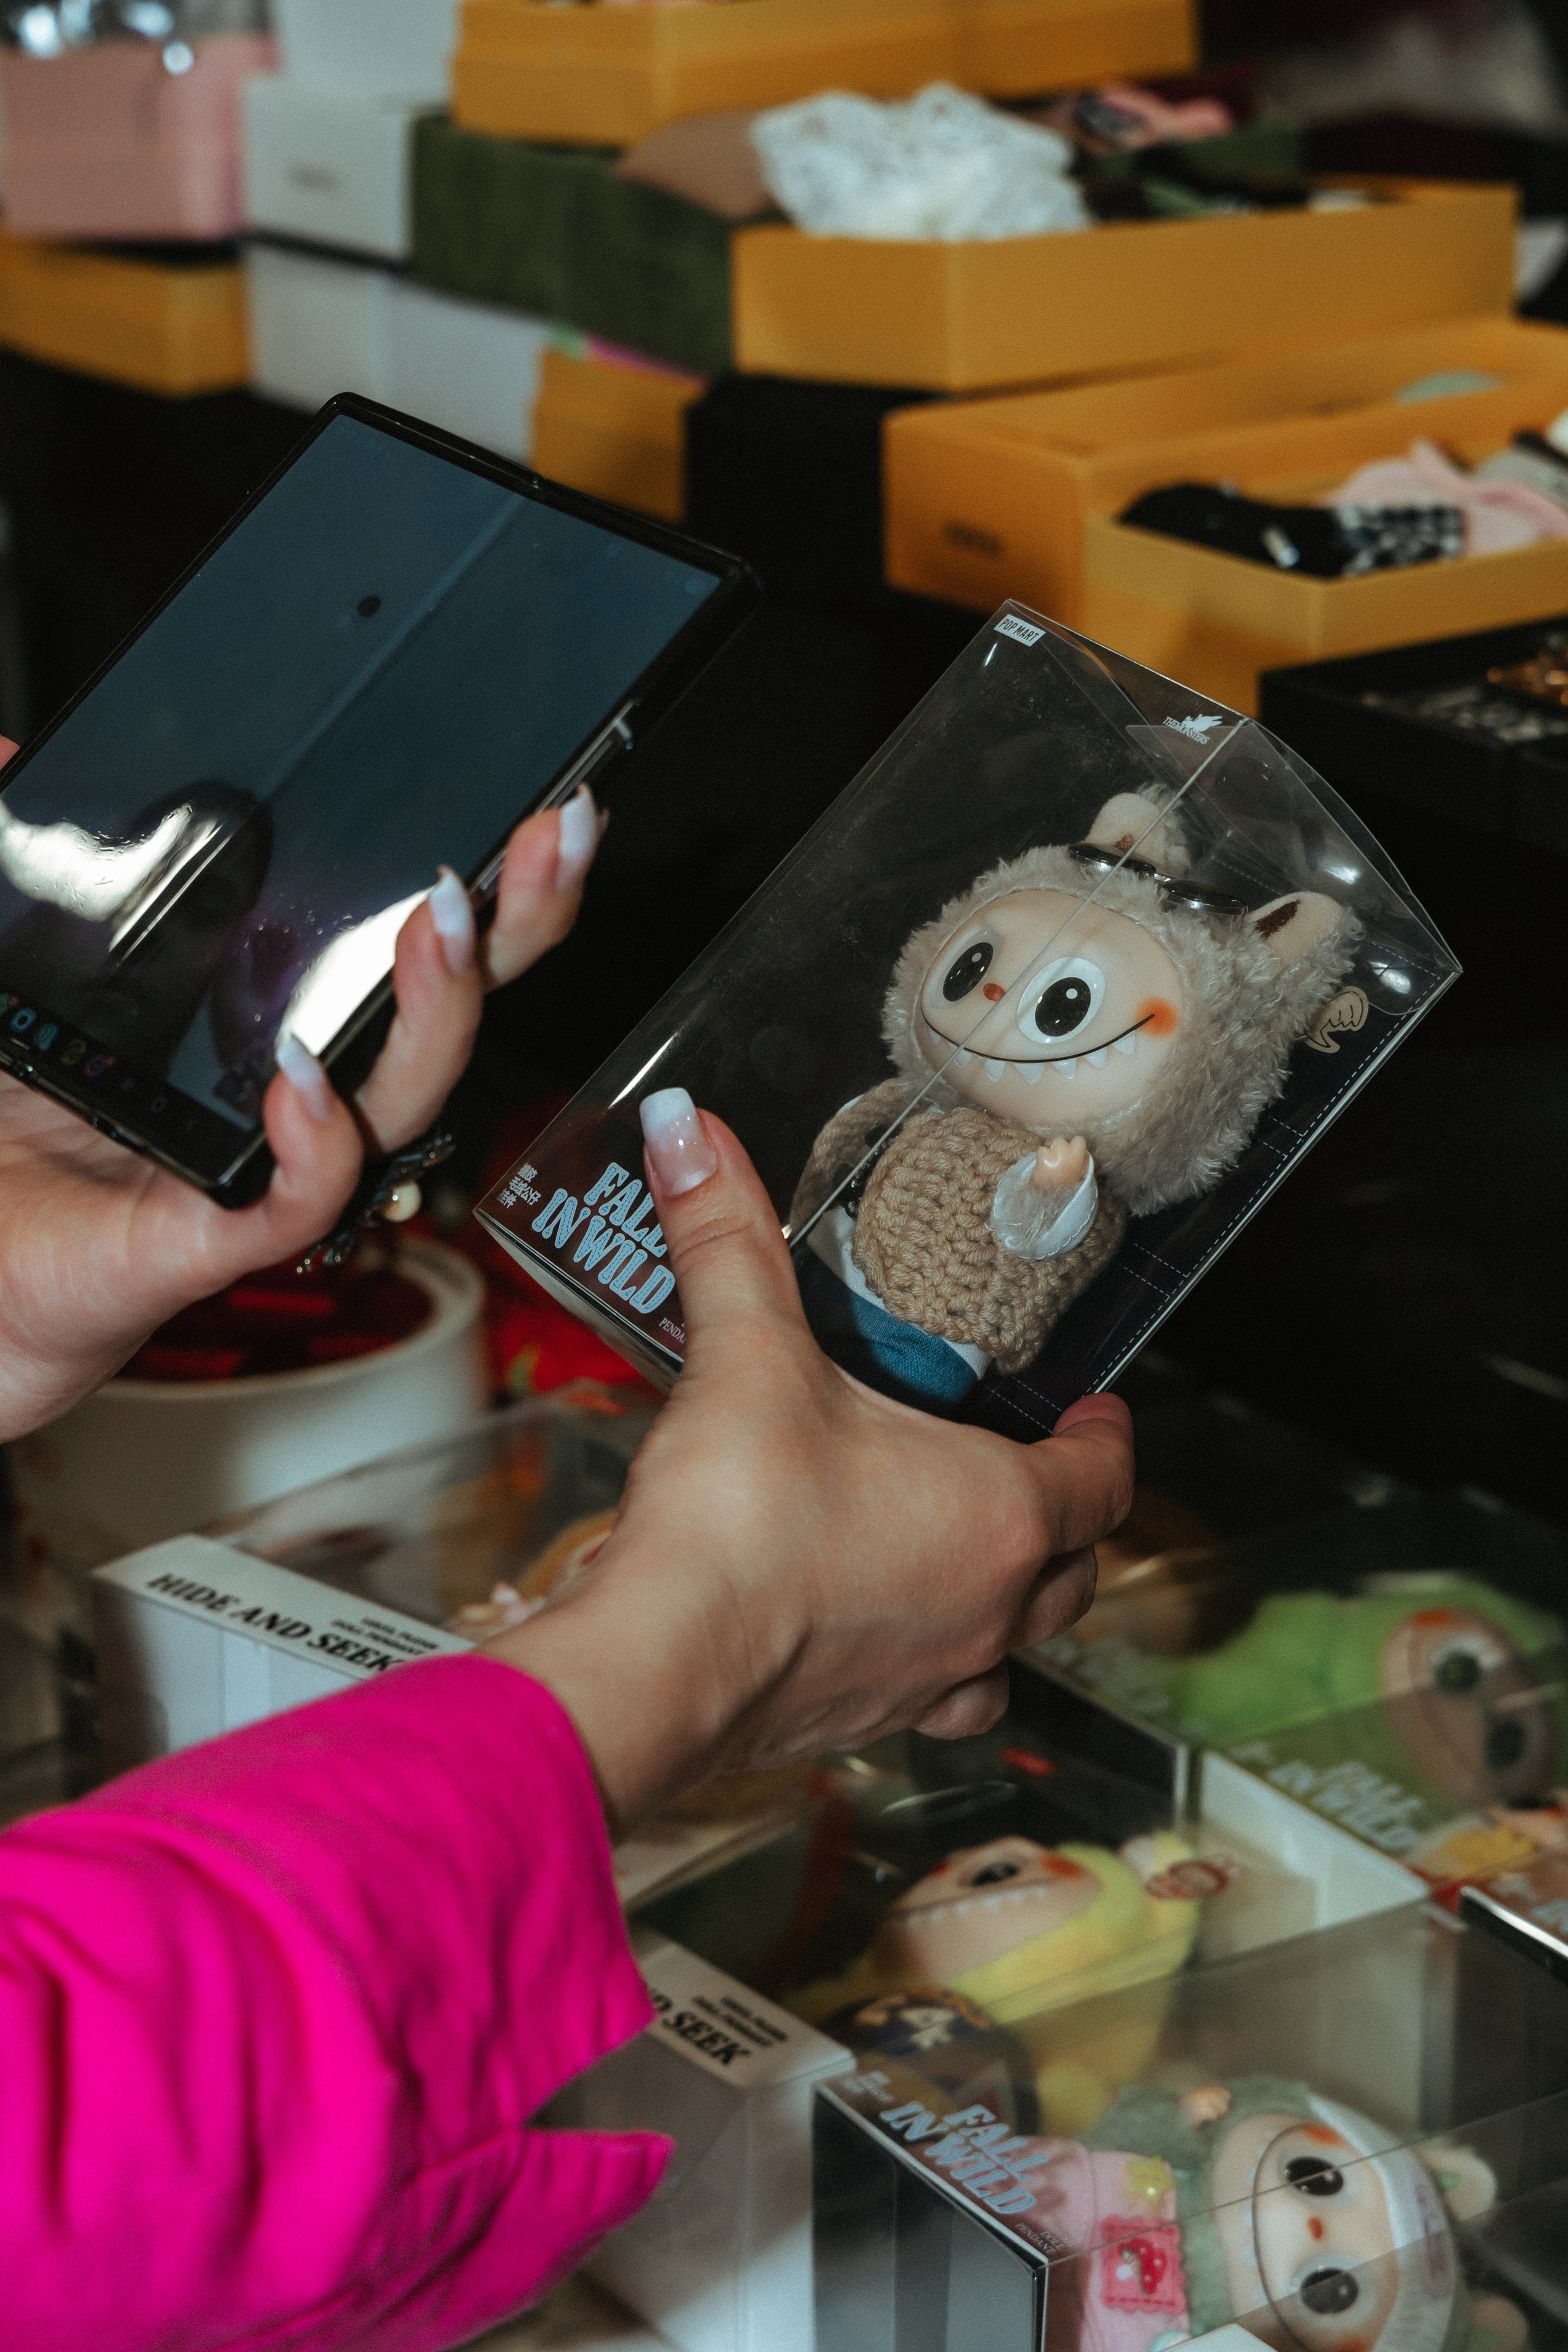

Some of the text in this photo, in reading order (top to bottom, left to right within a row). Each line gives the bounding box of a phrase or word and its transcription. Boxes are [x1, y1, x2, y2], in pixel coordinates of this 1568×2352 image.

[999, 619, 1039, 643] POP MART
[496, 1188, 518, 1209] 挂件
[509, 1176, 542, 1206] 毛绒公仔
[532, 1188, 676, 1314] IN WILD
[146, 1572, 241, 1612] HIDE
[228, 1606, 312, 1640] AND
[306, 1632, 405, 1673] SEEK
[661, 2011, 751, 2065] SEEK
[879, 2101, 1037, 2214] IN WILD
[943, 2103, 1049, 2181] FALL
[1015, 2223, 1057, 2253] PENDANT
